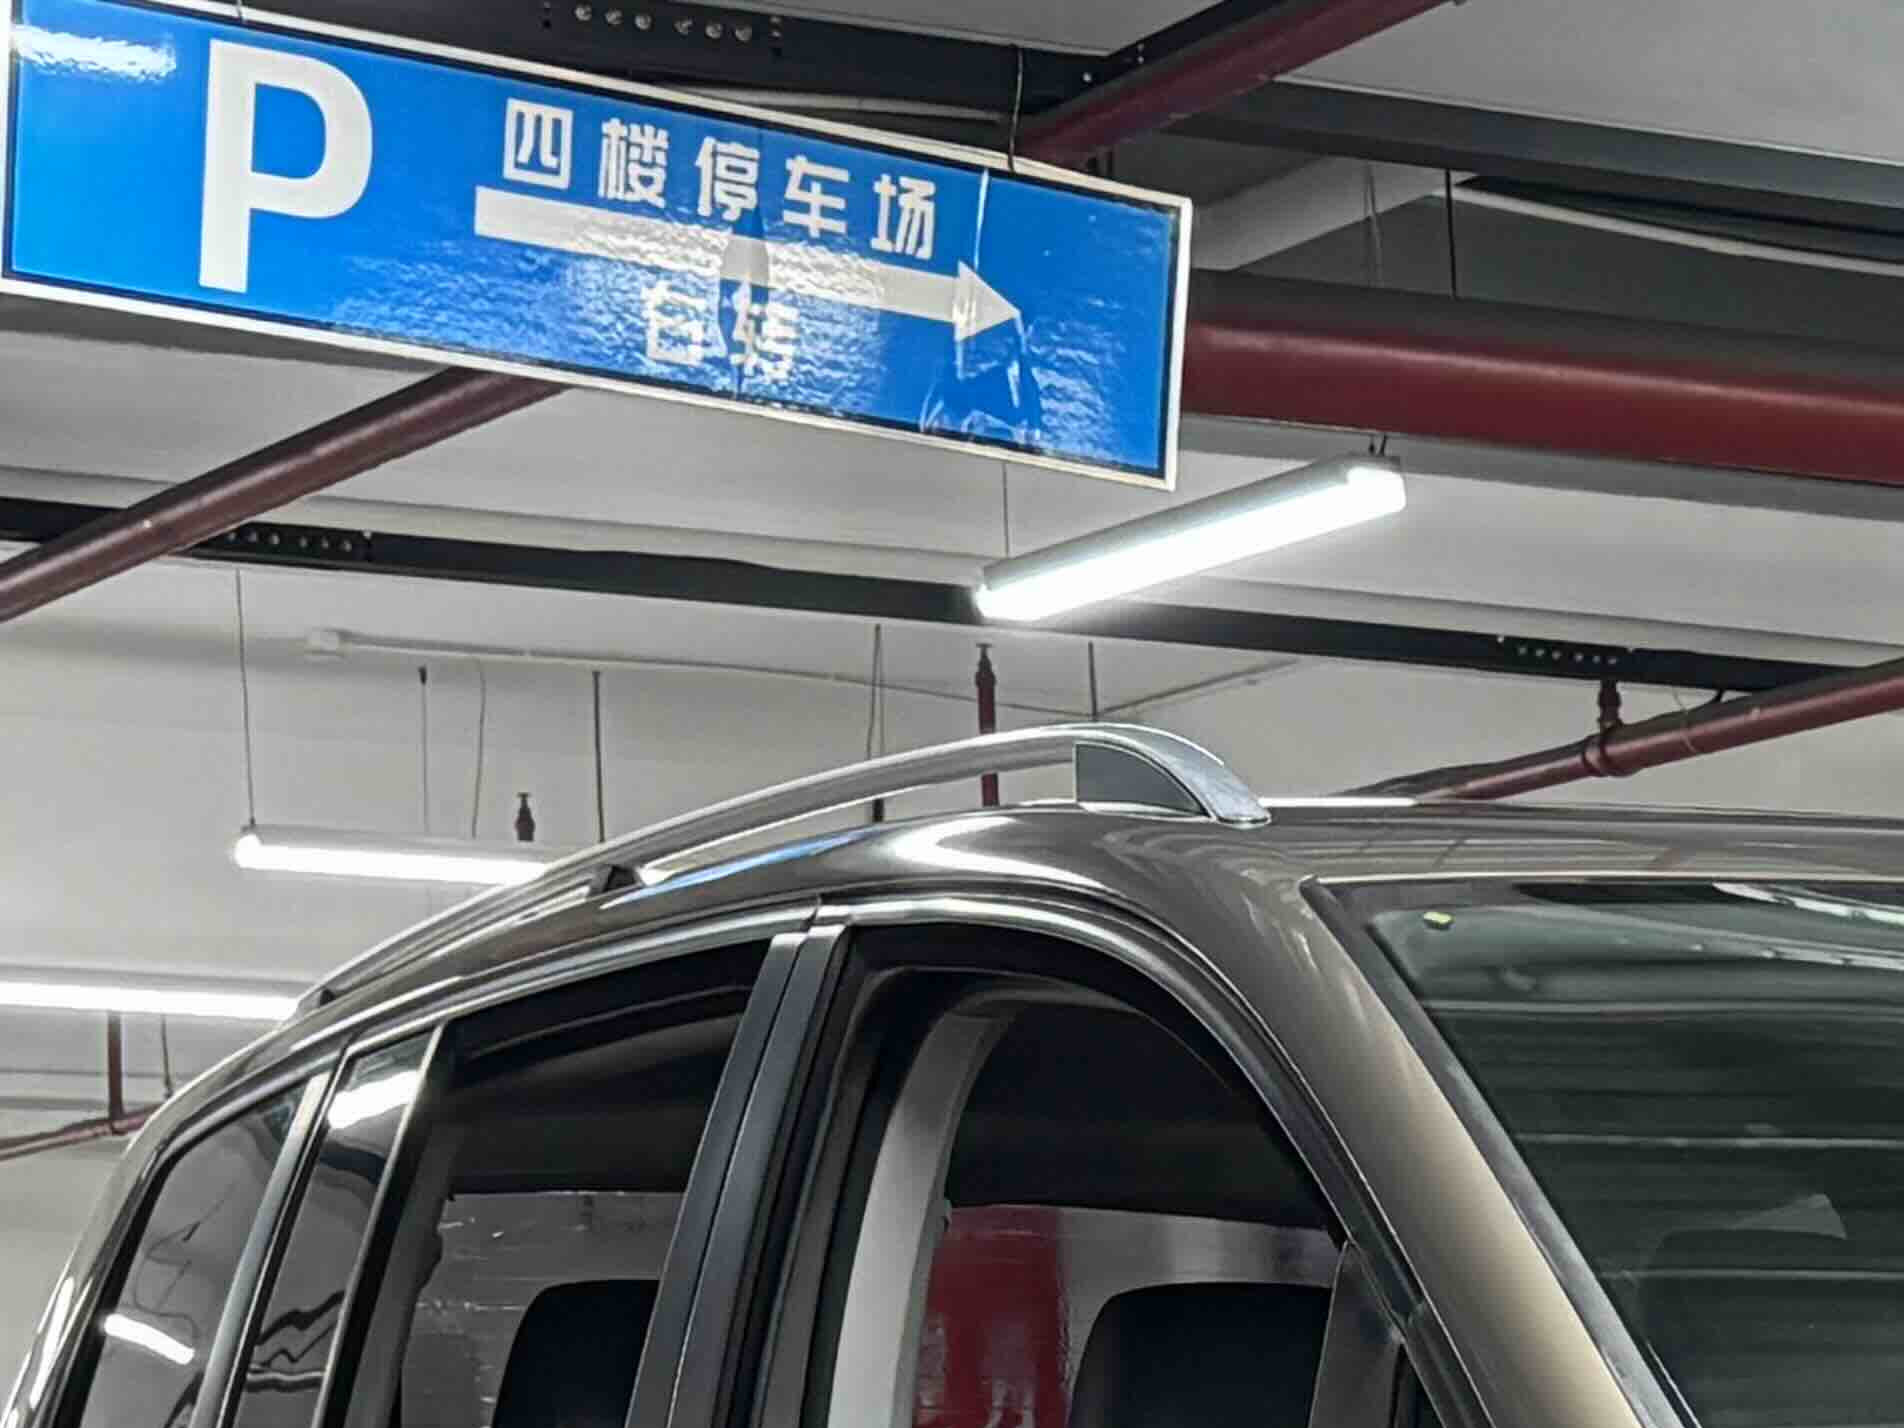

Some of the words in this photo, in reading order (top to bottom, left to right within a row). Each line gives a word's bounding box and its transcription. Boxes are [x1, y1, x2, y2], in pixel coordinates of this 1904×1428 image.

[198, 38, 375, 295] P
[502, 96, 938, 262] 四楼停车场
